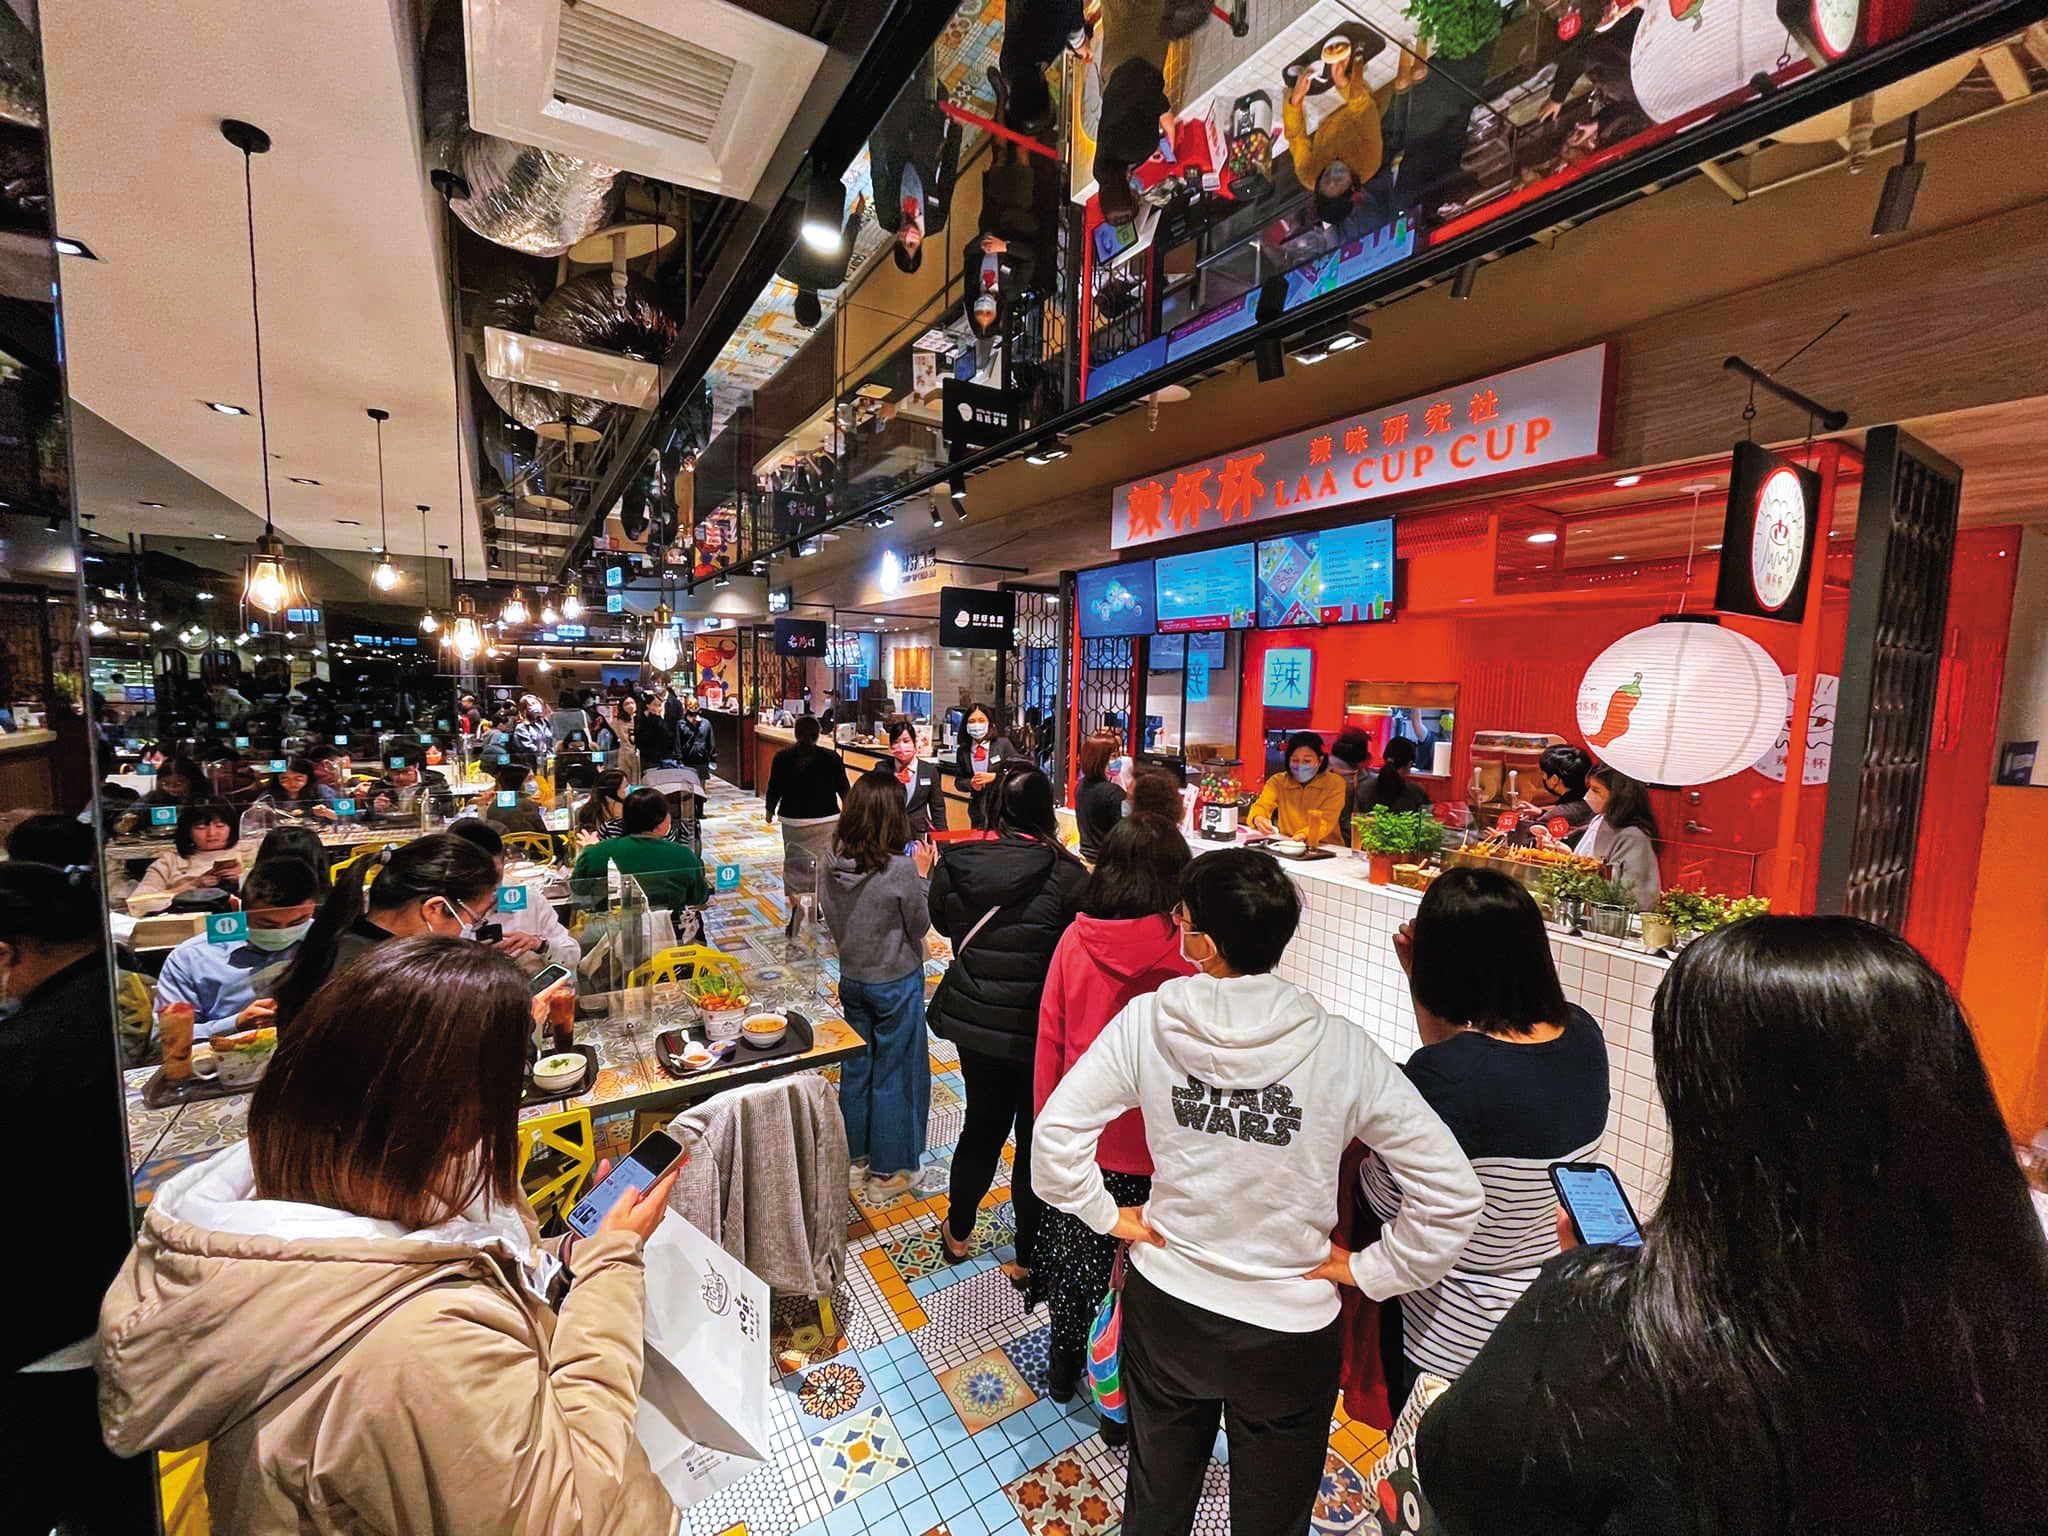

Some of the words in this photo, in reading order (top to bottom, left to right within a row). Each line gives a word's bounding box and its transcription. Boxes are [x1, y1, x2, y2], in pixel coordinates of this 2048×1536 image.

[1274, 468, 1338, 508] LAA
[1353, 444, 1435, 489] CUP
[1449, 416, 1553, 469] CUP
[1309, 388, 1500, 465] 辣味研究社
[1128, 452, 1265, 542] 辣杯杯
[1269, 657, 1303, 699] 辣
[1171, 1097, 1301, 1146] WARS
